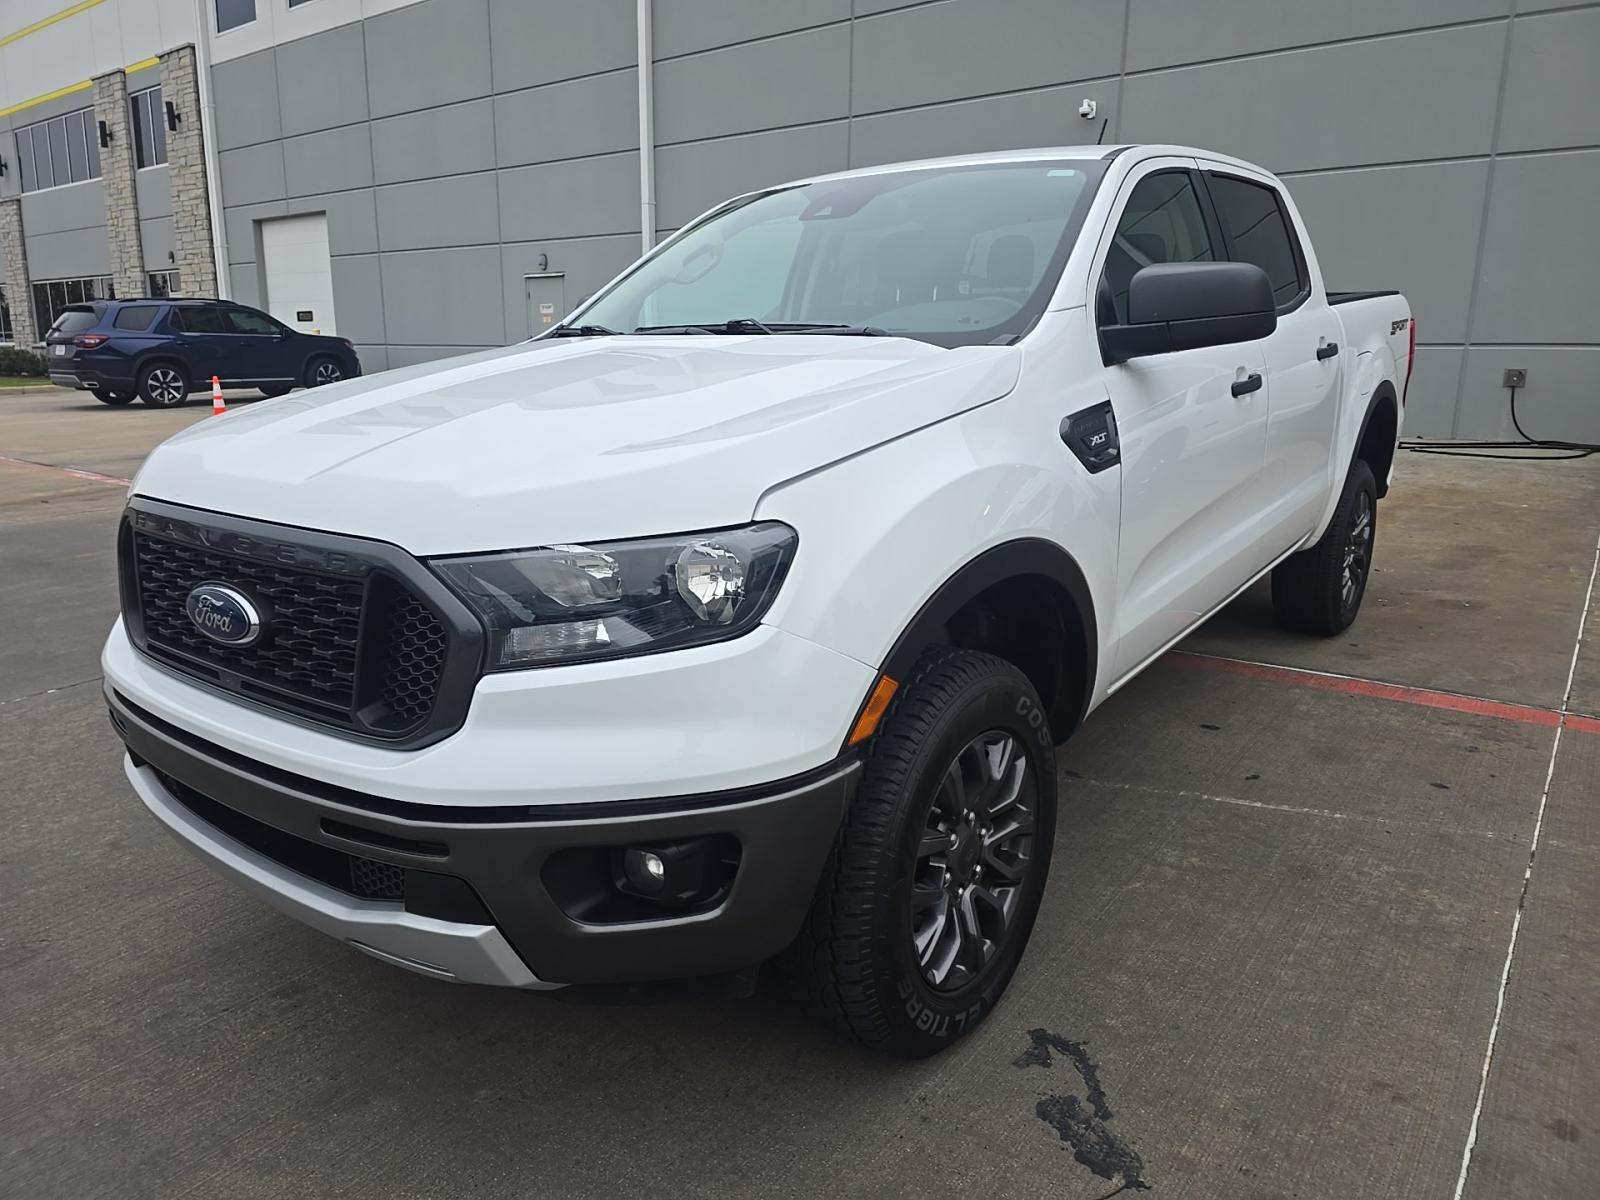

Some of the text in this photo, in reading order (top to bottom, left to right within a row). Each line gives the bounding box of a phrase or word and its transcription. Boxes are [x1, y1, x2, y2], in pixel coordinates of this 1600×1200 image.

[1090, 432, 1107, 446] XLT
[135, 513, 349, 573] RANGER
[194, 594, 233, 633] Ford
